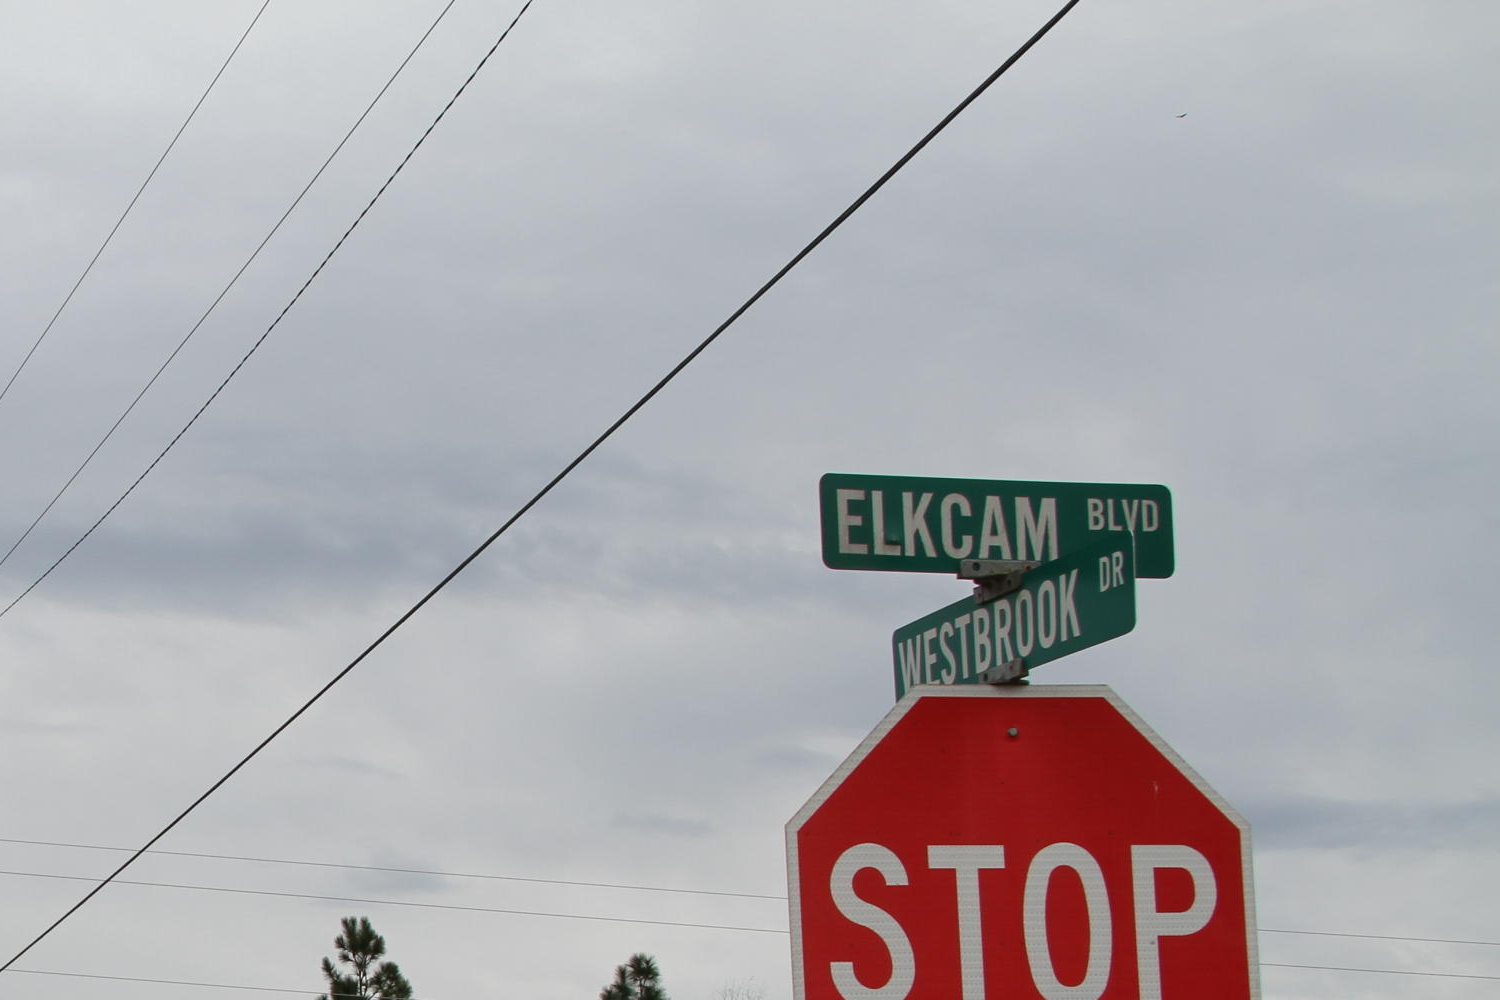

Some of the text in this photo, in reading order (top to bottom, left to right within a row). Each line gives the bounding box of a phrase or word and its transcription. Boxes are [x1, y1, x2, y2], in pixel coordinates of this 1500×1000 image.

[835, 488, 1159, 560] ELKCAM BLVD
[898, 551, 1125, 693] WESTBROOK DR
